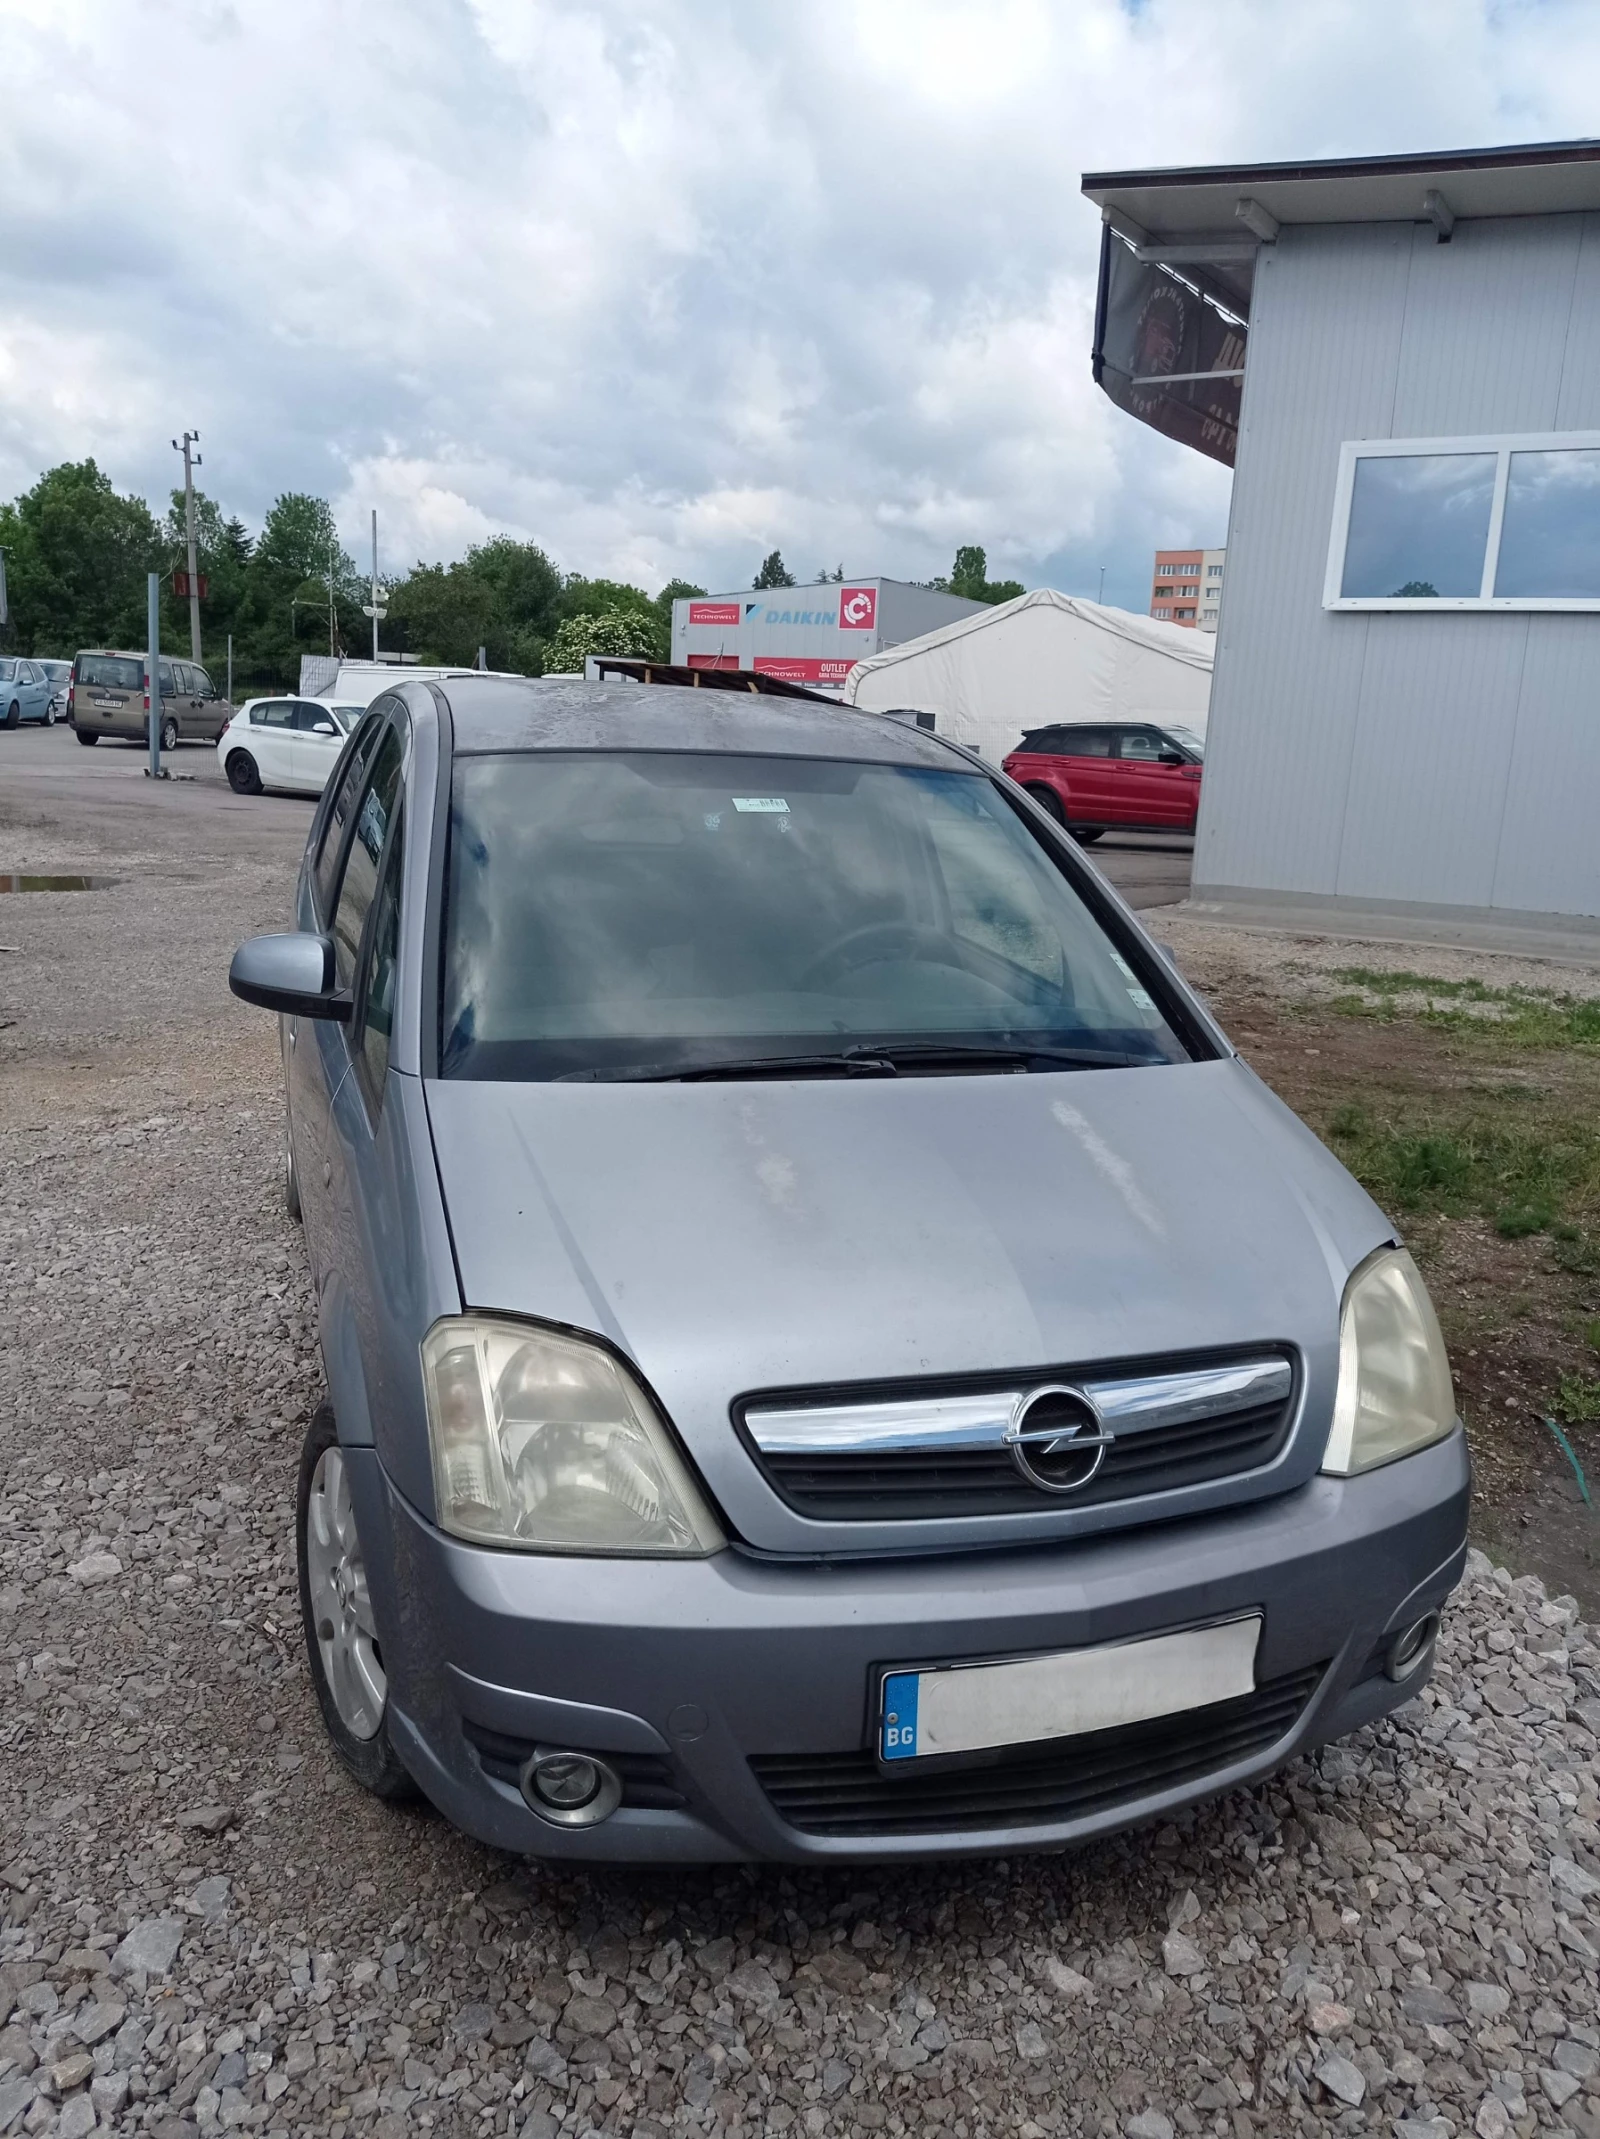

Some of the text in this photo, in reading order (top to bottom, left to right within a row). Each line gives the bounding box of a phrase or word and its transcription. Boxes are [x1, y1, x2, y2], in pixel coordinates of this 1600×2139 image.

[765, 610, 836, 625] DAIKIN
[821, 663, 847, 673] OUTLET
[887, 1726, 913, 1747] BG
